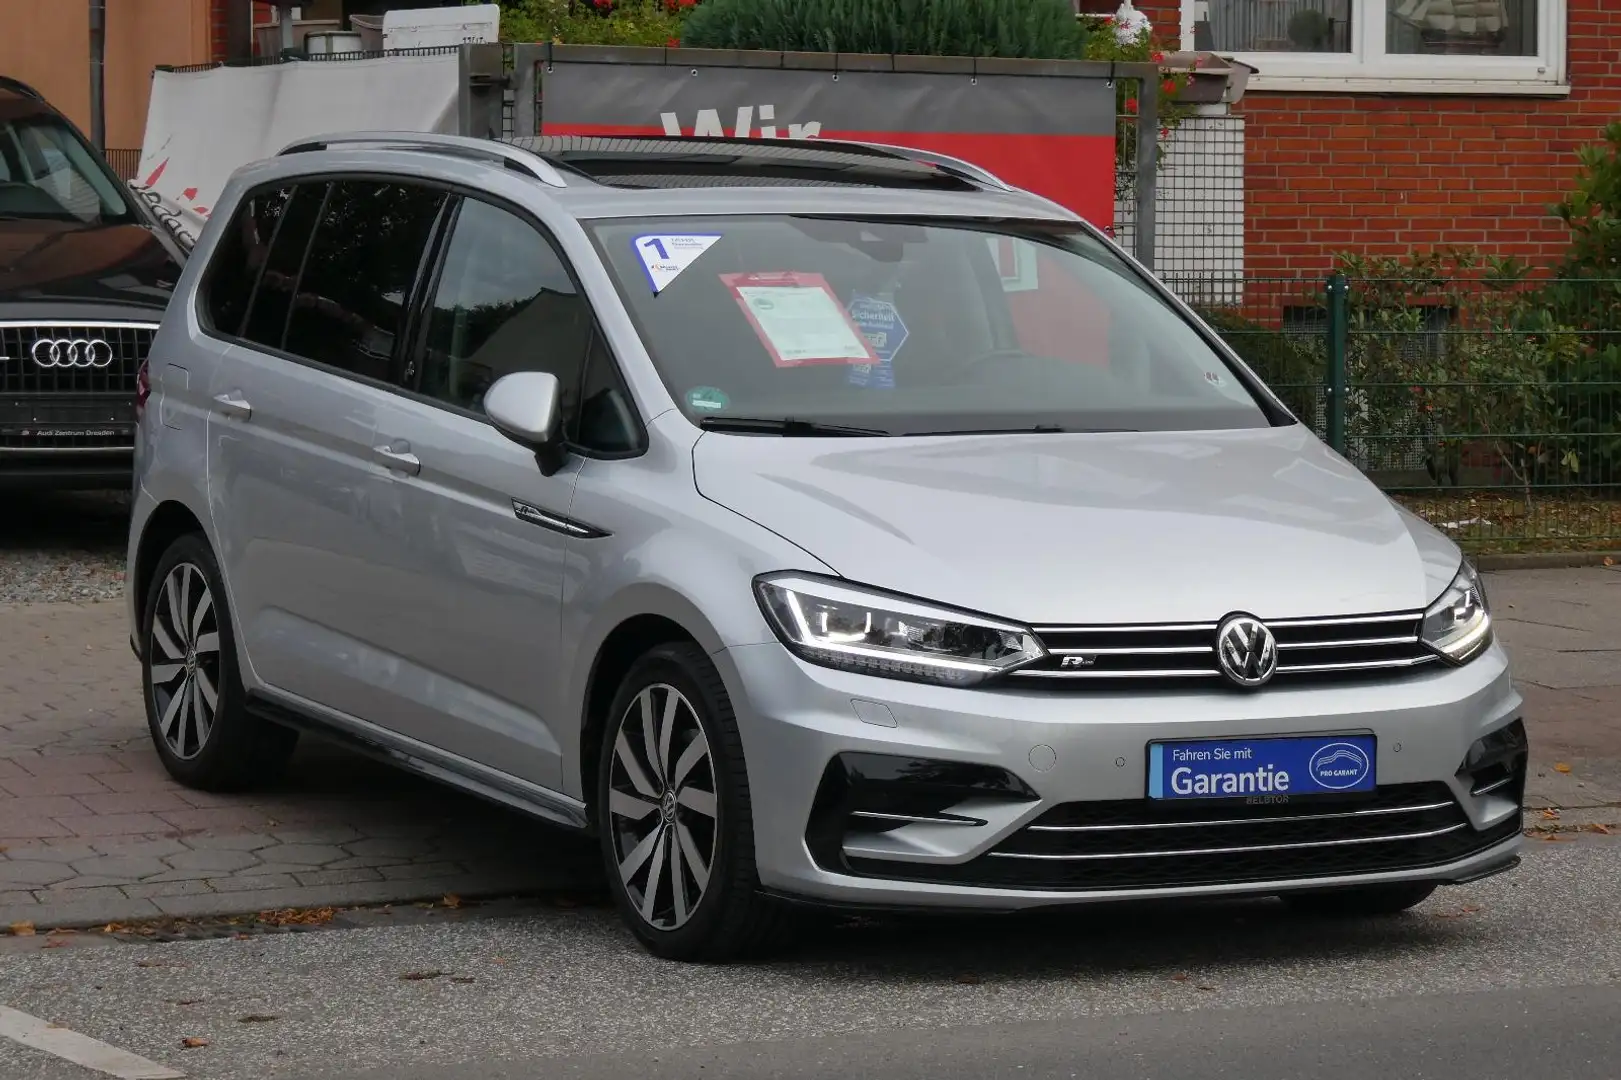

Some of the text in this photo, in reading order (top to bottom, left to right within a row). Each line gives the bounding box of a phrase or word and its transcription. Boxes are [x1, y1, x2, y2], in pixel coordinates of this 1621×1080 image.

[643, 238, 670, 260] 1
[1172, 747, 1253, 761] Fahren Sie mit
[1171, 764, 1290, 795] Garantie
